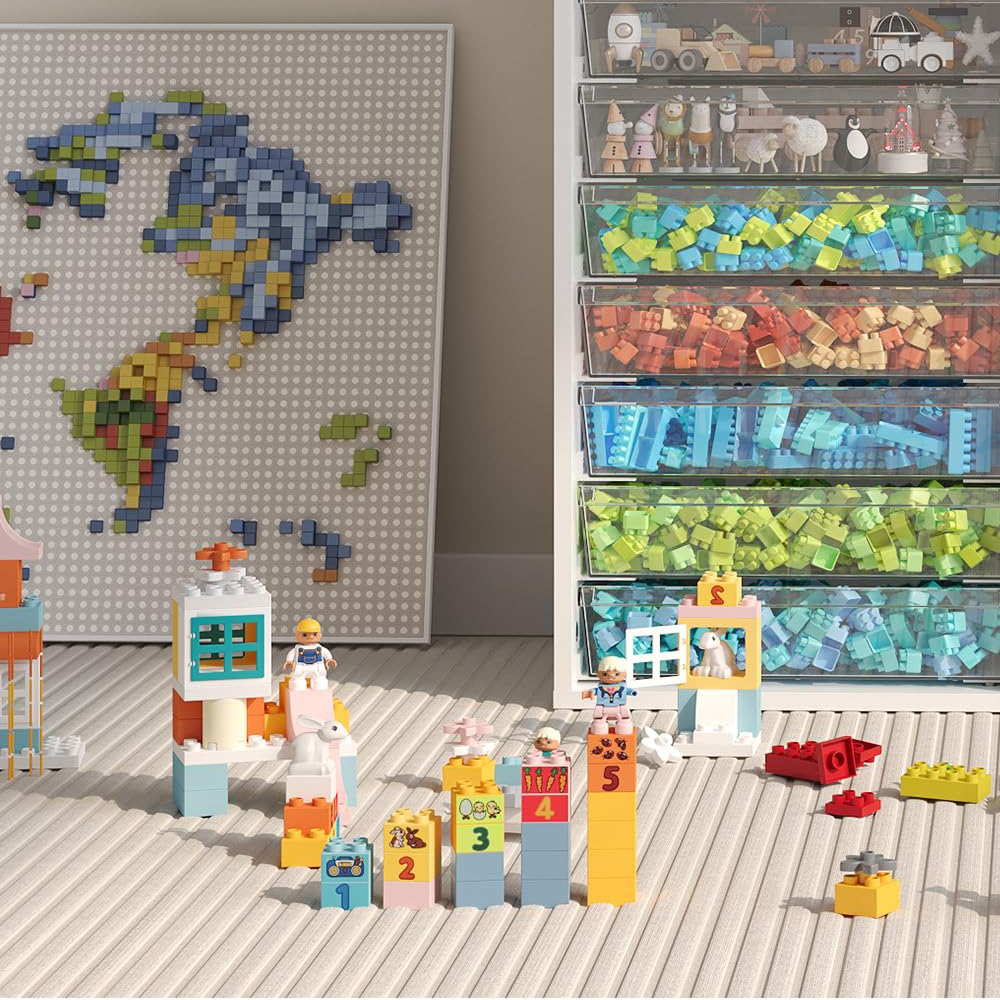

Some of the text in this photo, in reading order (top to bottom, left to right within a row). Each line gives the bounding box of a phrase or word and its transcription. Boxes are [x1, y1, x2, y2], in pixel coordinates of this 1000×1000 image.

[602, 765, 620, 792] 5
[535, 796, 555, 821] 4
[472, 826, 490, 852] 3
[398, 856, 416, 881] 2
[335, 883, 350, 911] 1
